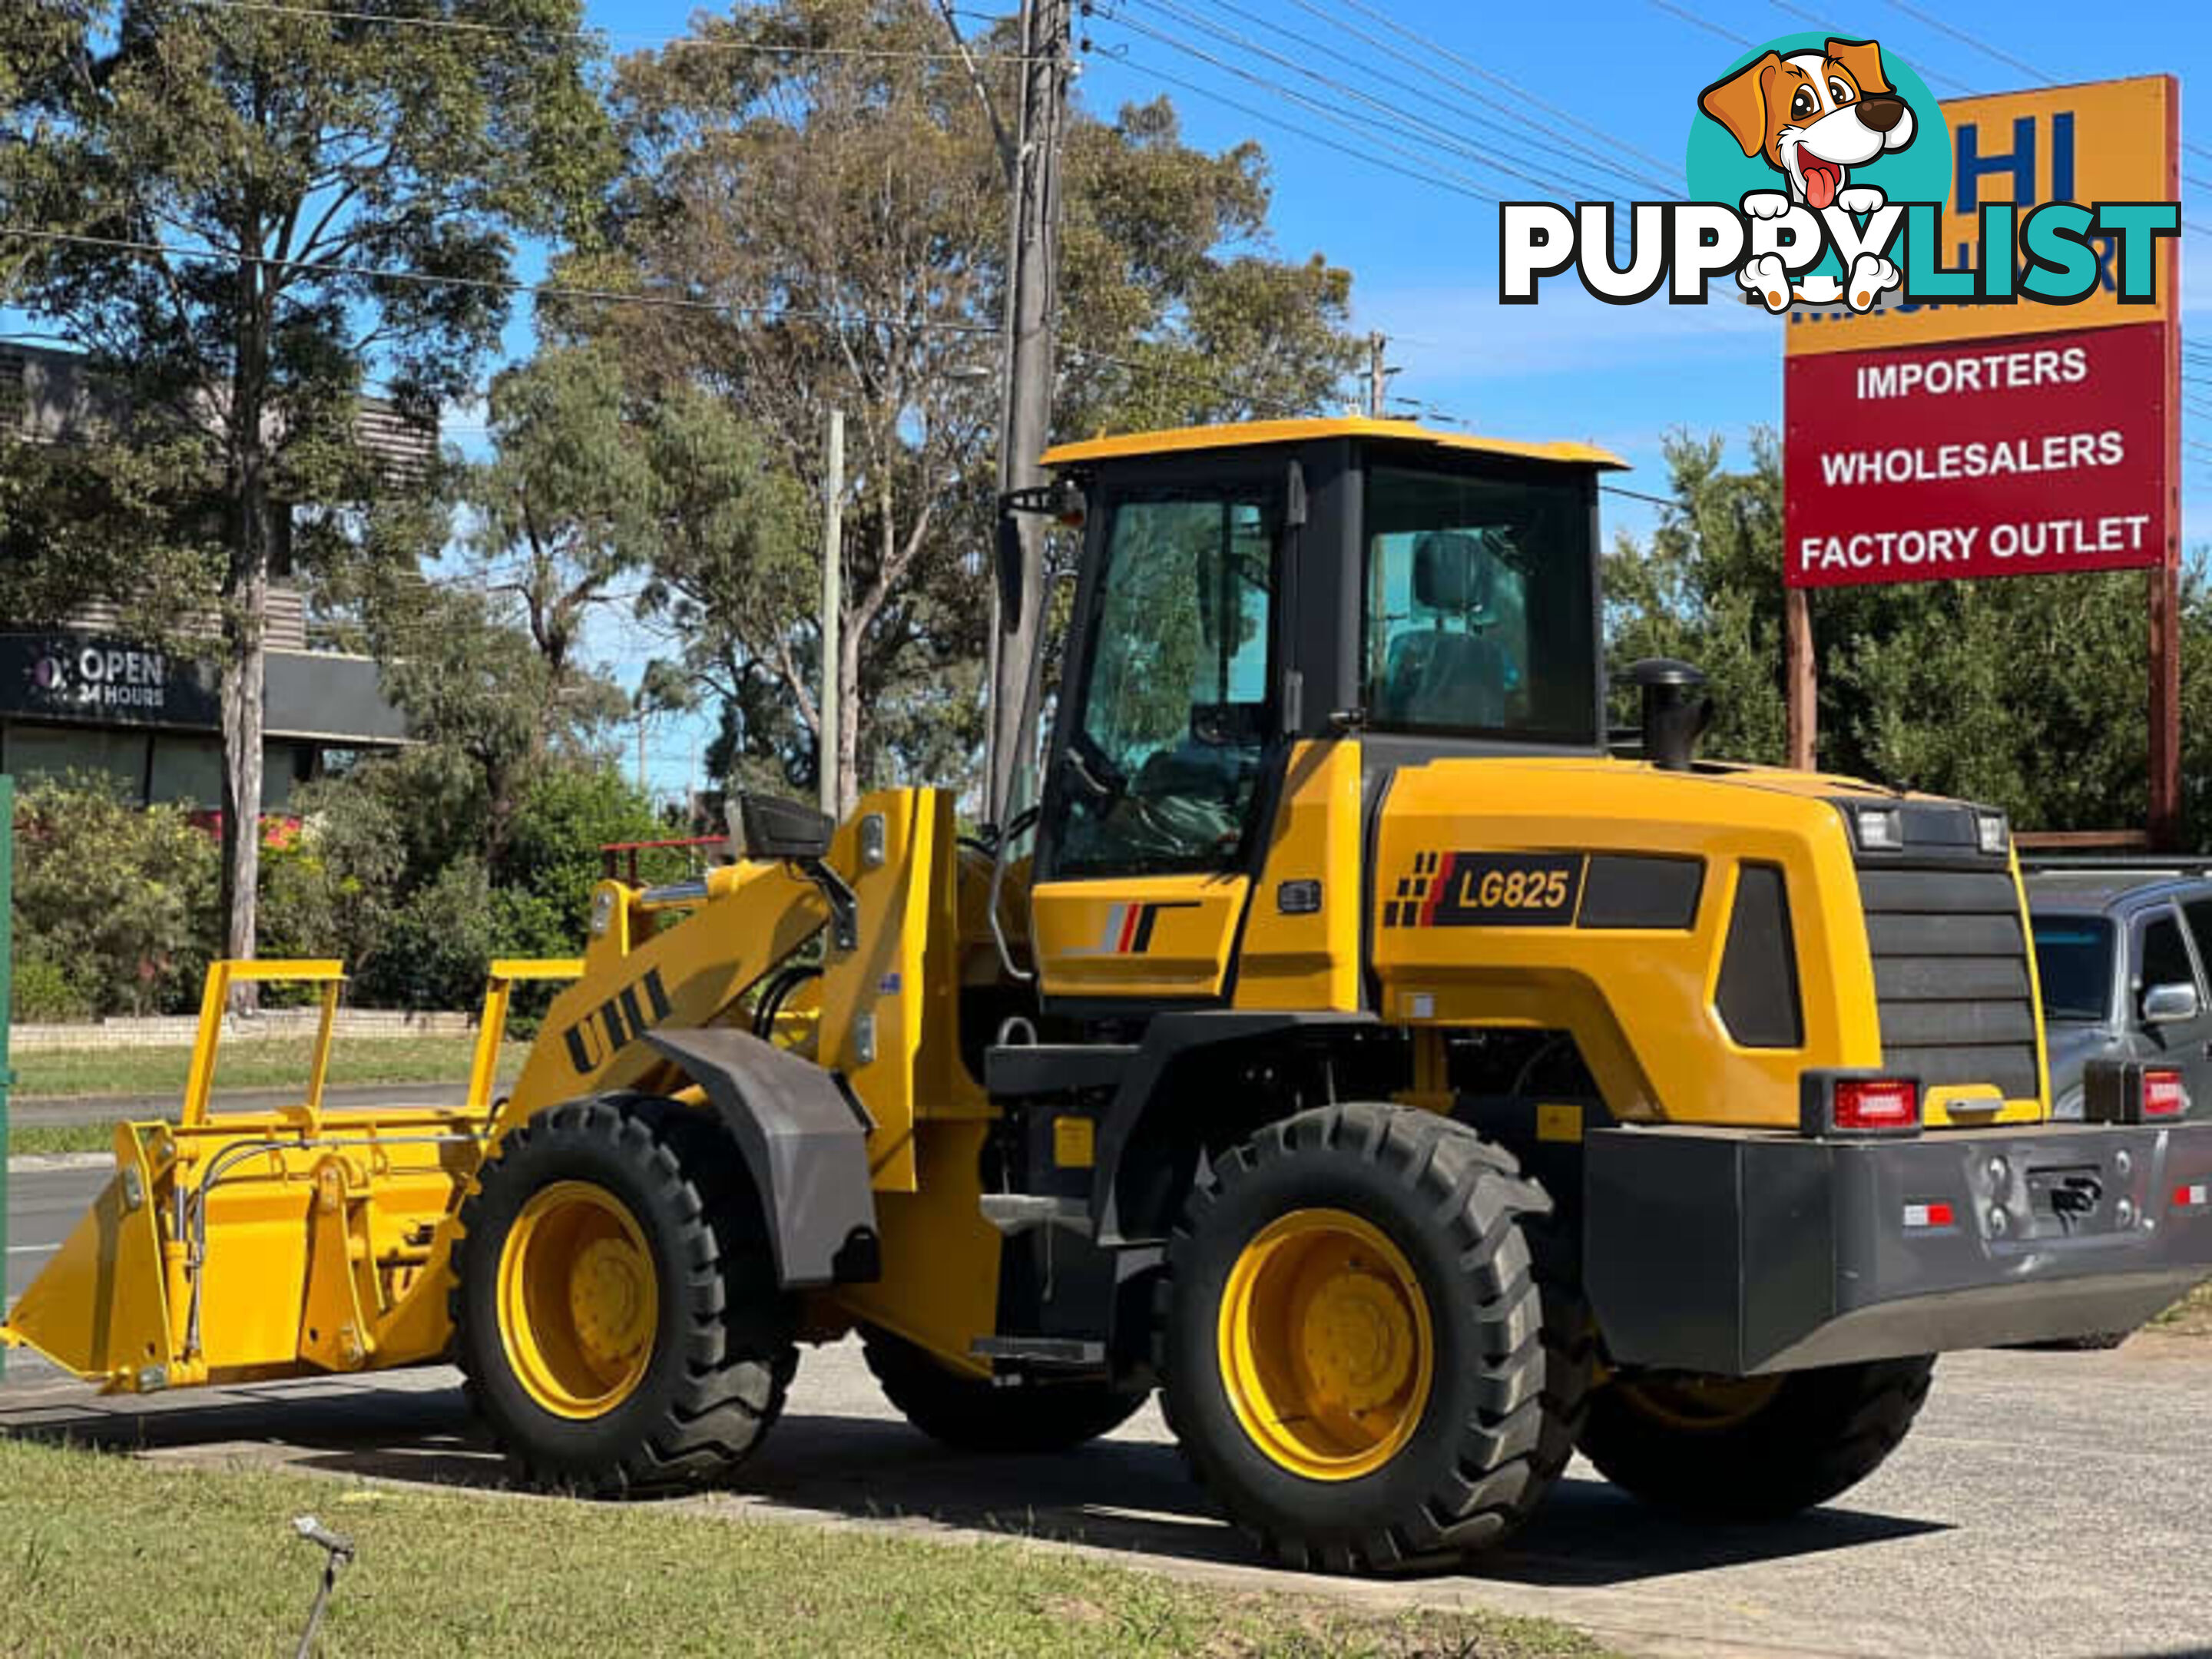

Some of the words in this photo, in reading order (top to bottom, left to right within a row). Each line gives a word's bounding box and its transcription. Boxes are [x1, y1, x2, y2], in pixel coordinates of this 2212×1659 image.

[1955, 111, 2075, 217] HI
[1856, 347, 2087, 399] IMPORTERS
[1821, 431, 2124, 487] WHOLESALERS
[1800, 527, 1979, 571] FACTORY
[1990, 515, 2149, 558] OUTLET
[79, 648, 164, 685] OPEN
[104, 685, 164, 707] HOURS
[1459, 870, 1569, 908] LG825
